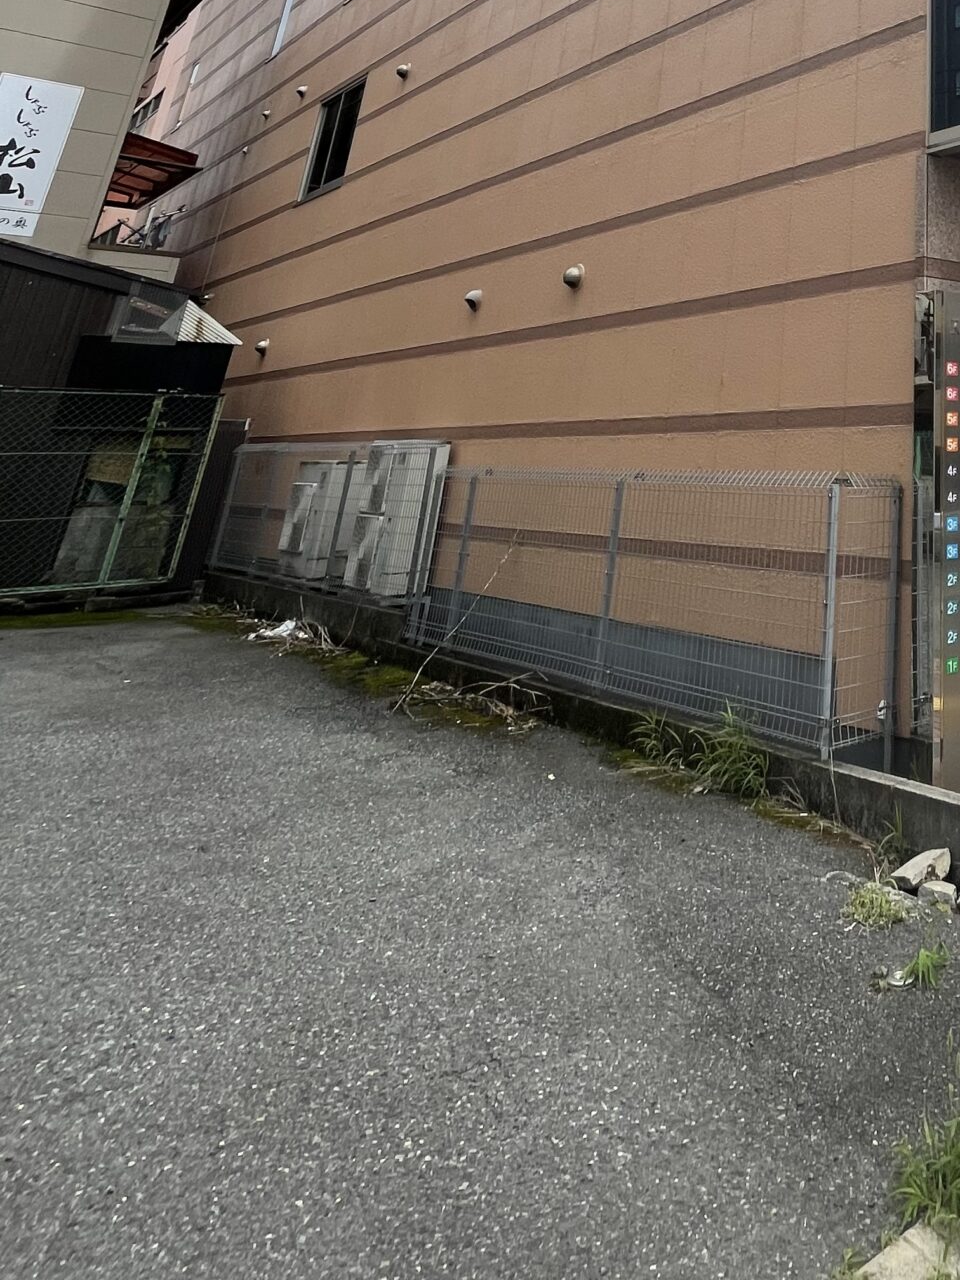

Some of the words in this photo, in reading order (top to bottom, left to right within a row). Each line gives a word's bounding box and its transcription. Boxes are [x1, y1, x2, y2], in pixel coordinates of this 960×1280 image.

[946, 362, 958, 376] 6F
[946, 387, 958, 401] 6F
[946, 412, 958, 426] 5F
[946, 438, 958, 452] 5F
[947, 465, 958, 477] 4F
[947, 491, 957, 503] 4F
[946, 518, 958, 531] 3F
[946, 546, 958, 559] 3F
[947, 574, 958, 587] 2F
[947, 602, 958, 615] 2F
[947, 631, 958, 644] 2F
[947, 658, 958, 673] 1F
